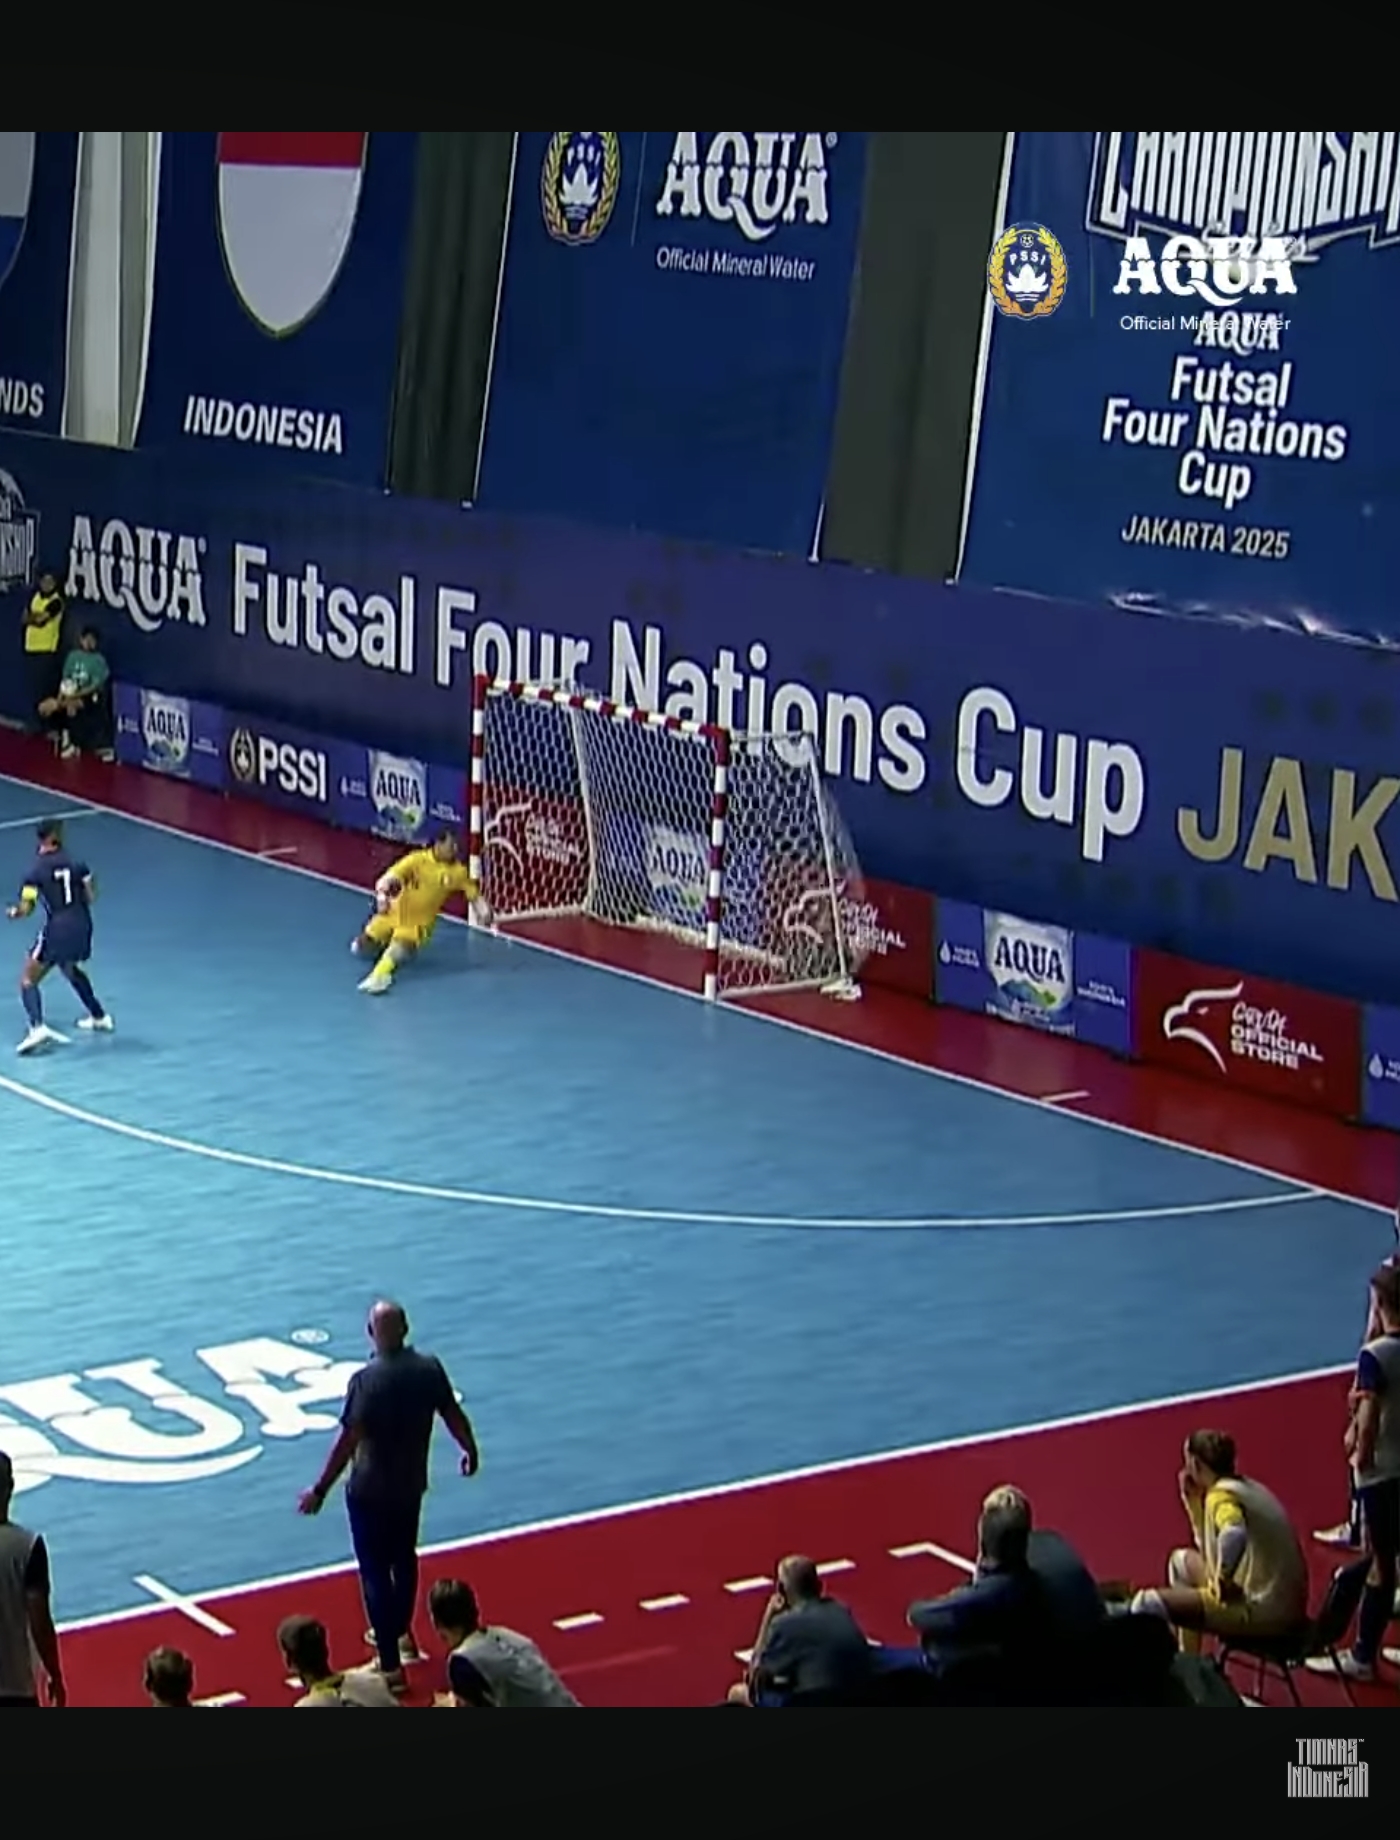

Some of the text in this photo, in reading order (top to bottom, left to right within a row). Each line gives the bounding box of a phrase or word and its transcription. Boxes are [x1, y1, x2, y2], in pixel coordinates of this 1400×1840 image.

[656, 246, 816, 281] Official Mineral Water
[1193, 310, 1280, 356] AQUA
[1171, 356, 1293, 409] Futsal
[183, 395, 344, 455] INDONESIA
[1102, 398, 1348, 461] Four Nations
[1178, 450, 1253, 510] Cup
[1121, 514, 1291, 559] JAKARTA 2025
[64, 515, 1400, 902] AQUA Futsal Four Nations Cup JAK
[147, 706, 186, 742] AQUA
[259, 736, 328, 802] PSSI
[376, 767, 422, 806] AQUA
[53, 868, 73, 905] 7
[994, 936, 1066, 984] AQUA
[1230, 1025, 1325, 1062] OFFICIAL
[1230, 1039, 1299, 1070] STORE
